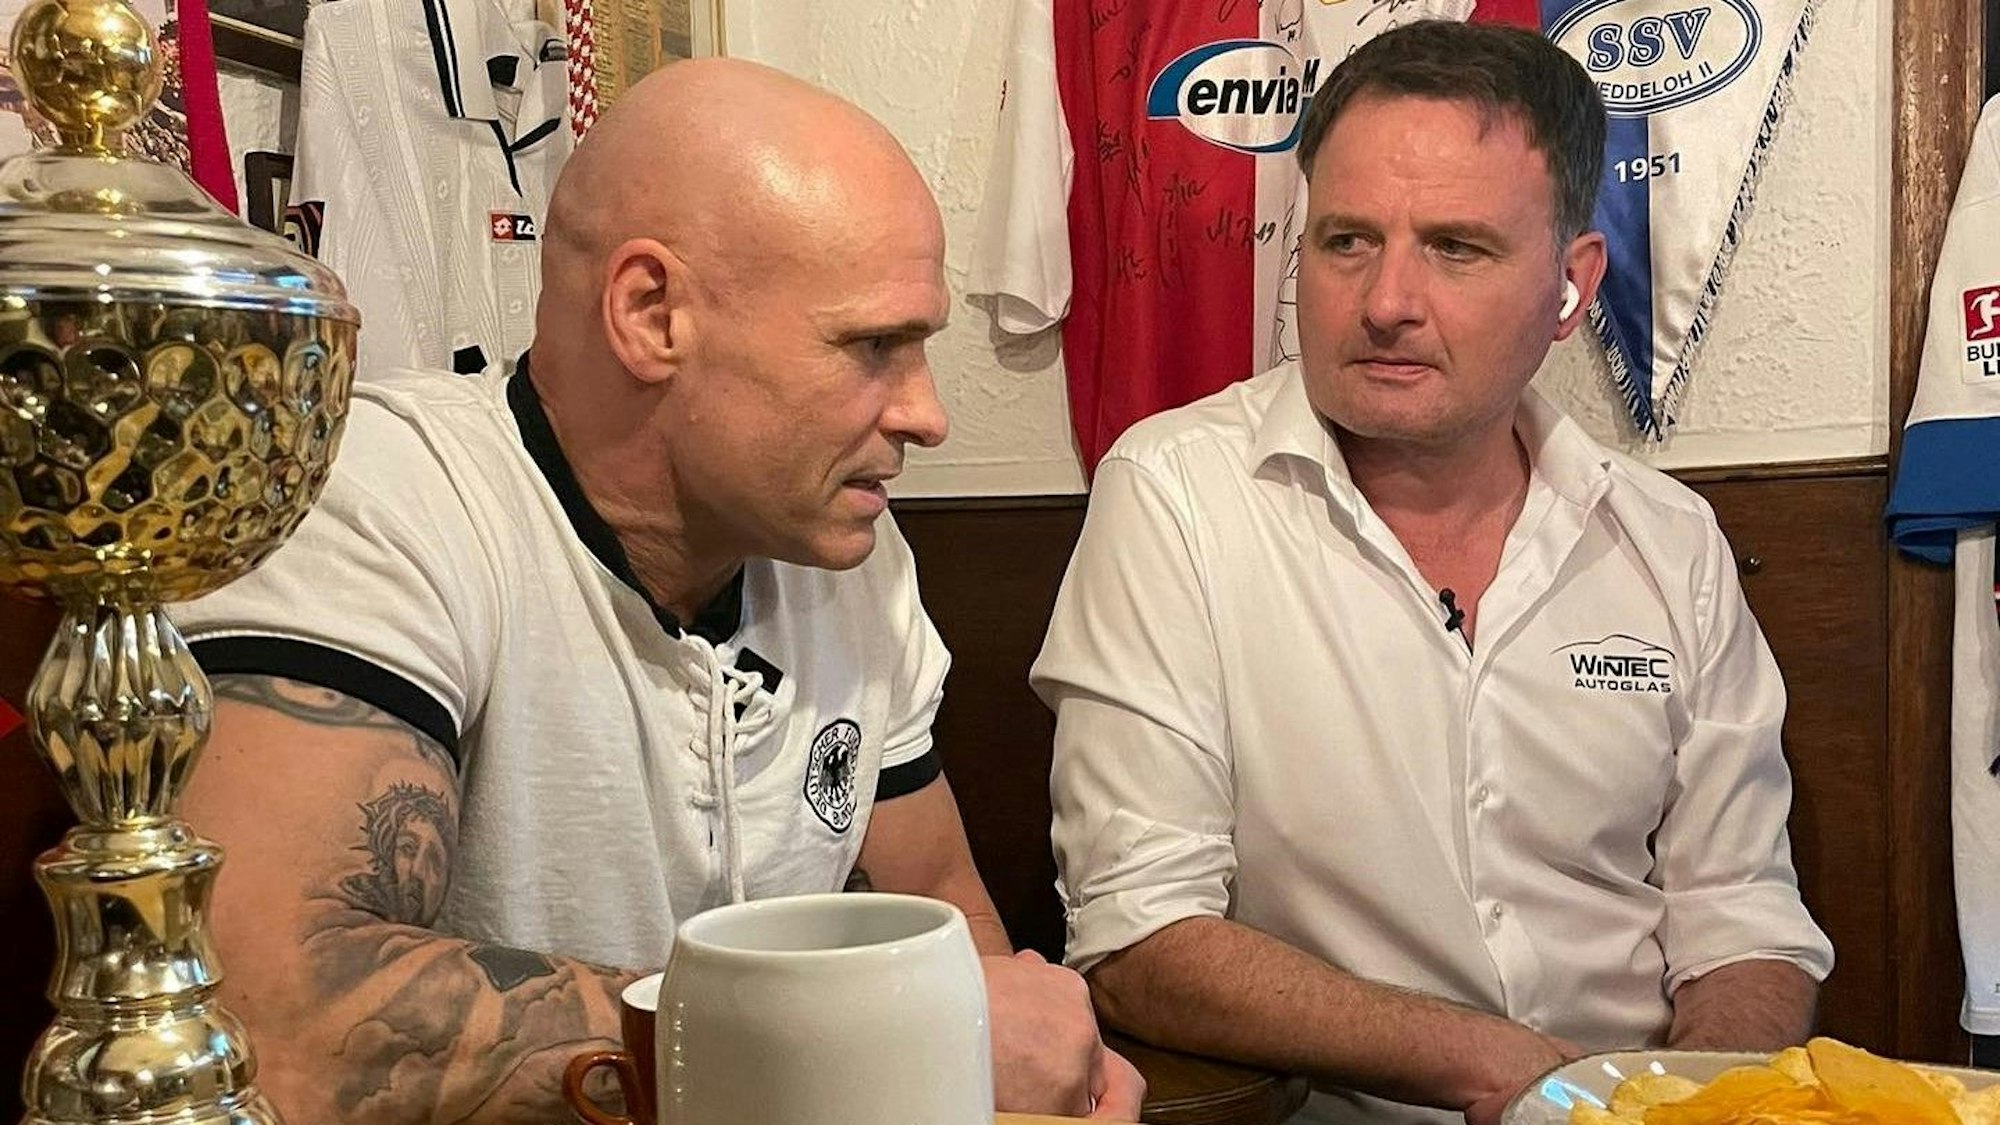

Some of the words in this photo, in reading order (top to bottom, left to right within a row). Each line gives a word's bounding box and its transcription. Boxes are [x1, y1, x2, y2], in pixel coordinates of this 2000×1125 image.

[1586, 8, 1710, 72] SSV
[1597, 70, 1693, 99] EDDELOH
[1615, 153, 1681, 183] 1951
[1967, 342, 2000, 361] BU
[1984, 360, 2000, 376] L
[1574, 678, 1671, 693] AUTOGLAS
